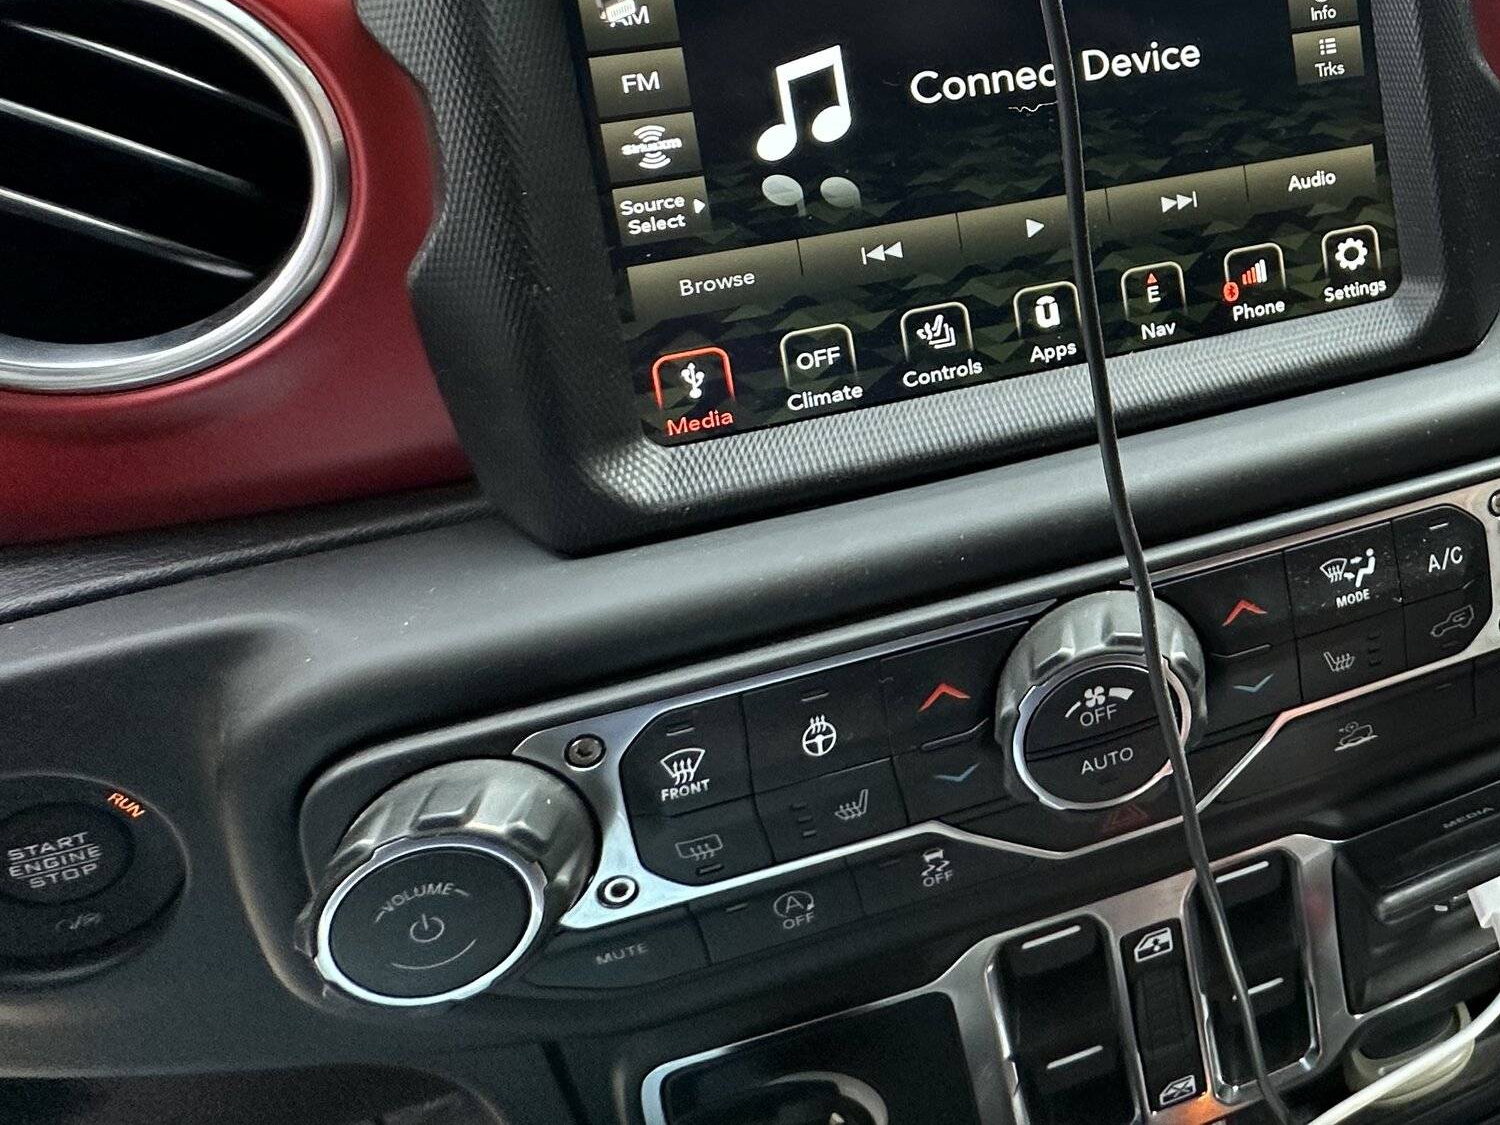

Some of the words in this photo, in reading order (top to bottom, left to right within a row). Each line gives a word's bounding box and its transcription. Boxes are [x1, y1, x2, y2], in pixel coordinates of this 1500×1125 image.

[1310, 4, 1337, 21] Info
[909, 63, 1058, 106] Connec
[1081, 40, 1202, 82] Device
[1314, 61, 1345, 78] Trks
[621, 72, 661, 94] FM
[1287, 169, 1337, 193] Audio
[619, 195, 686, 217] Source
[628, 214, 687, 236] Select
[678, 271, 756, 297] Browse
[1323, 278, 1387, 304] Settings
[1232, 298, 1286, 322] Phone
[1141, 320, 1177, 341] Nav
[796, 345, 841, 371] OFF
[1029, 339, 1078, 365] Apps
[902, 358, 983, 389] Controls
[786, 384, 864, 412] Climate
[665, 410, 735, 437] Media
[1426, 545, 1464, 573] A/C
[1335, 588, 1371, 609] MODE
[1079, 703, 1118, 729] OFF
[1080, 746, 1135, 775] AUTO
[660, 778, 711, 802] FRONT
[106, 792, 146, 819] RUN
[1442, 805, 1496, 830] MEDIA
[6, 831, 89, 861] START
[8, 845, 102, 878] ENGINE
[29, 862, 98, 889] STOP
[922, 868, 954, 888] OFF
[381, 882, 455, 913] VOLUME
[782, 911, 815, 931] OFF
[595, 942, 650, 966] MUTE
